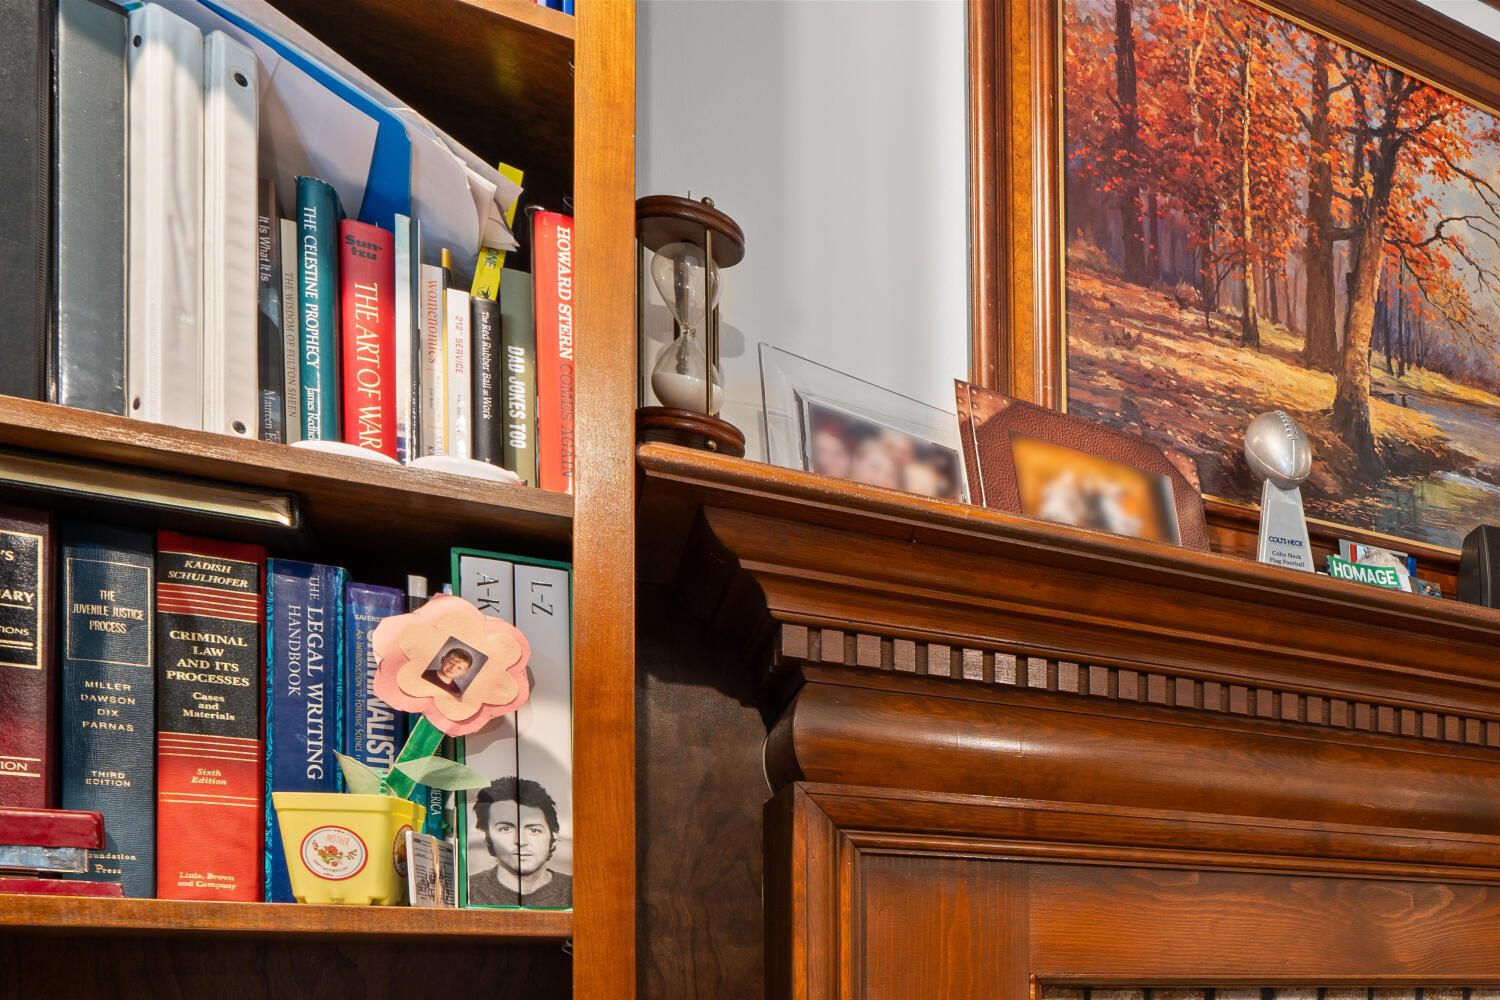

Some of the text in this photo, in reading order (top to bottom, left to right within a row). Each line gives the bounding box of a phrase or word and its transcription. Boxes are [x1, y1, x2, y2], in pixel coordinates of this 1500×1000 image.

[259, 216, 271, 281] It Is What It Is
[345, 234, 383, 251] Sun-
[352, 247, 377, 261] tzu
[304, 206, 321, 368] THE CELESTINE PROPHECY
[427, 280, 441, 364] womenomics
[482, 312, 490, 323] The
[482, 324, 490, 339] Red
[284, 273, 297, 418] THE WISDOM OF FULTON SHEEN
[557, 225, 575, 479] HOWARD STERN COMES AGAIN
[456, 338, 464, 374] SERVICE
[482, 342, 491, 371] Rubber
[354, 282, 382, 449] THE ART OF WAR
[482, 373, 491, 388] Ball
[508, 346, 527, 449] DAD JOKES TOO
[264, 389, 277, 429] Maureen
[304, 386, 320, 441] James Redfie
[482, 396, 492, 419] Work
[1269, 536, 1303, 547] COLTS NECK
[1272, 550, 1302, 560] Colts Neck
[184, 560, 232, 574] KADISH
[1282, 559, 1305, 568] Football
[168, 570, 249, 588] SCHULHOFER
[1332, 560, 1398, 585] HOMAGE
[100, 590, 116, 602] THE
[476, 572, 500, 614] A-K
[531, 580, 553, 616] L-Z
[72, 604, 144, 621] JUVENILE JUSTICE
[354, 614, 382, 623] SAFERS
[90, 620, 127, 633] PROCESS
[170, 630, 248, 647] CRIMINAL
[192, 646, 225, 657] LAW
[288, 604, 301, 696] HANDBOOK
[176, 658, 240, 672] AND ITS
[166, 671, 250, 687] PROCESSES
[306, 576, 324, 780] THE LEGAL WRITING
[85, 680, 132, 692] MILLER
[81, 694, 136, 705] DAWSON
[192, 692, 225, 702] Cases
[97, 708, 119, 717] DIX
[198, 702, 219, 711] and
[183, 709, 236, 721] Materials
[82, 721, 135, 732] PARNAS
[91, 770, 126, 779] THIRD
[196, 768, 222, 777] Sixth
[86, 778, 131, 787] EDITION
[191, 776, 227, 785] Edition
[94, 863, 122, 874] Press
[206, 873, 235, 881] Brown
[196, 881, 237, 890] Company
